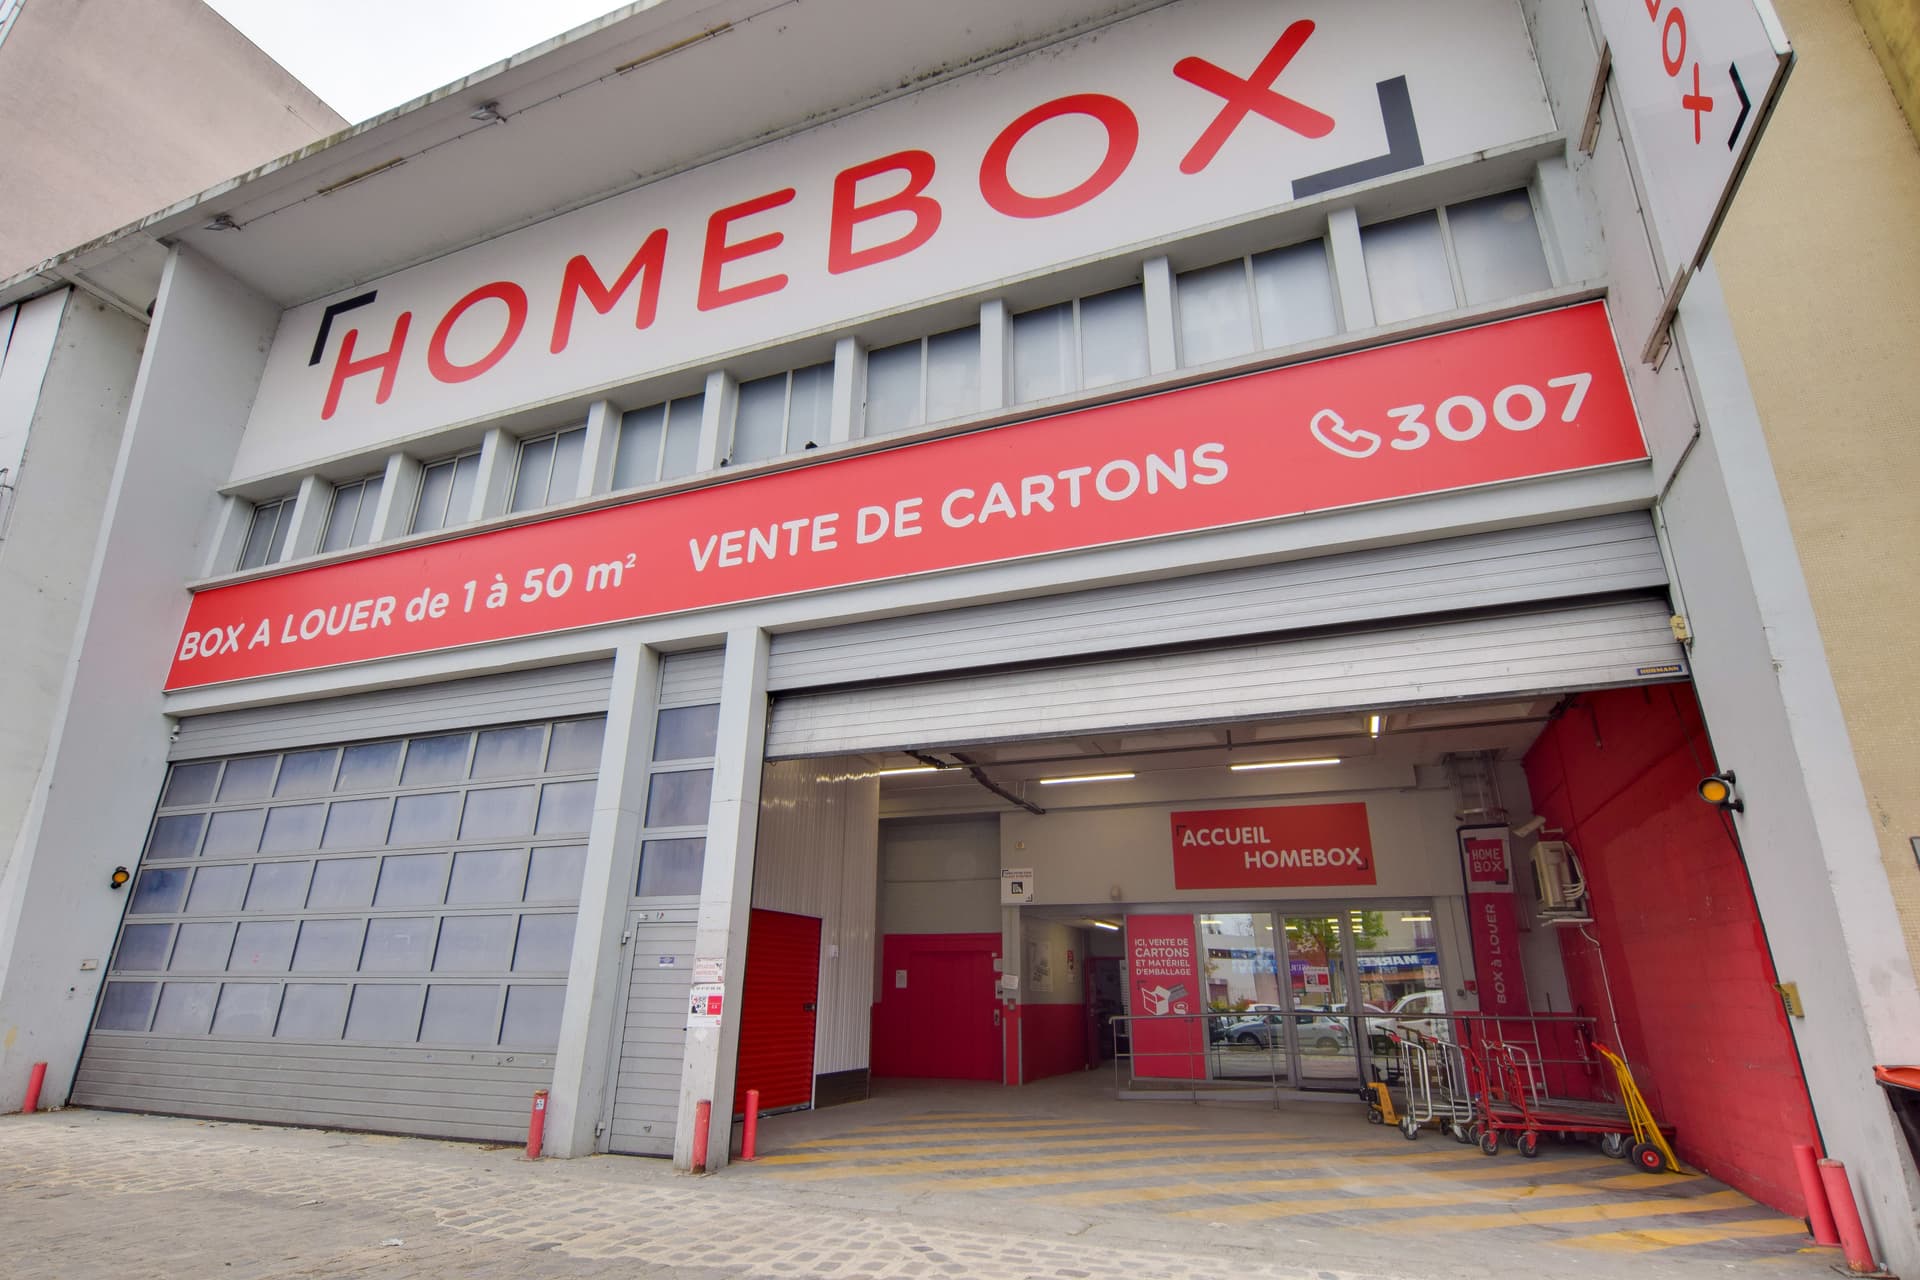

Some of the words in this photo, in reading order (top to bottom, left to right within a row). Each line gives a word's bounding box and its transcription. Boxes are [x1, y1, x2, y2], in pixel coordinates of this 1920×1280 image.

[1644, 0, 1713, 144] OX
[321, 19, 1335, 420] HOMEBOX
[1387, 372, 1592, 450] 3007
[689, 513, 840, 571] VENTE
[856, 497, 923, 544] DE
[941, 442, 1229, 528] CARTONS
[179, 623, 245, 661] BOX
[248, 619, 270, 650] A
[280, 596, 397, 644] LOUER
[405, 588, 450, 621] de
[464, 580, 477, 612] 1
[486, 574, 507, 608] à
[520, 564, 573, 602] 50
[1182, 826, 1271, 847] ACCUEIL
[1245, 848, 1363, 869] HOMEBOX
[1472, 848, 1500, 860] HOME
[1474, 861, 1502, 872] BOX
[1485, 903, 1501, 954] LOUER
[1136, 948, 1189, 957] CARTONS
[1149, 938, 1175, 946] VENTE
[1177, 938, 1188, 946] DE
[1149, 958, 1190, 967] MATÉRIEL
[1491, 959, 1501, 969] à
[1493, 970, 1507, 1004] BOX
